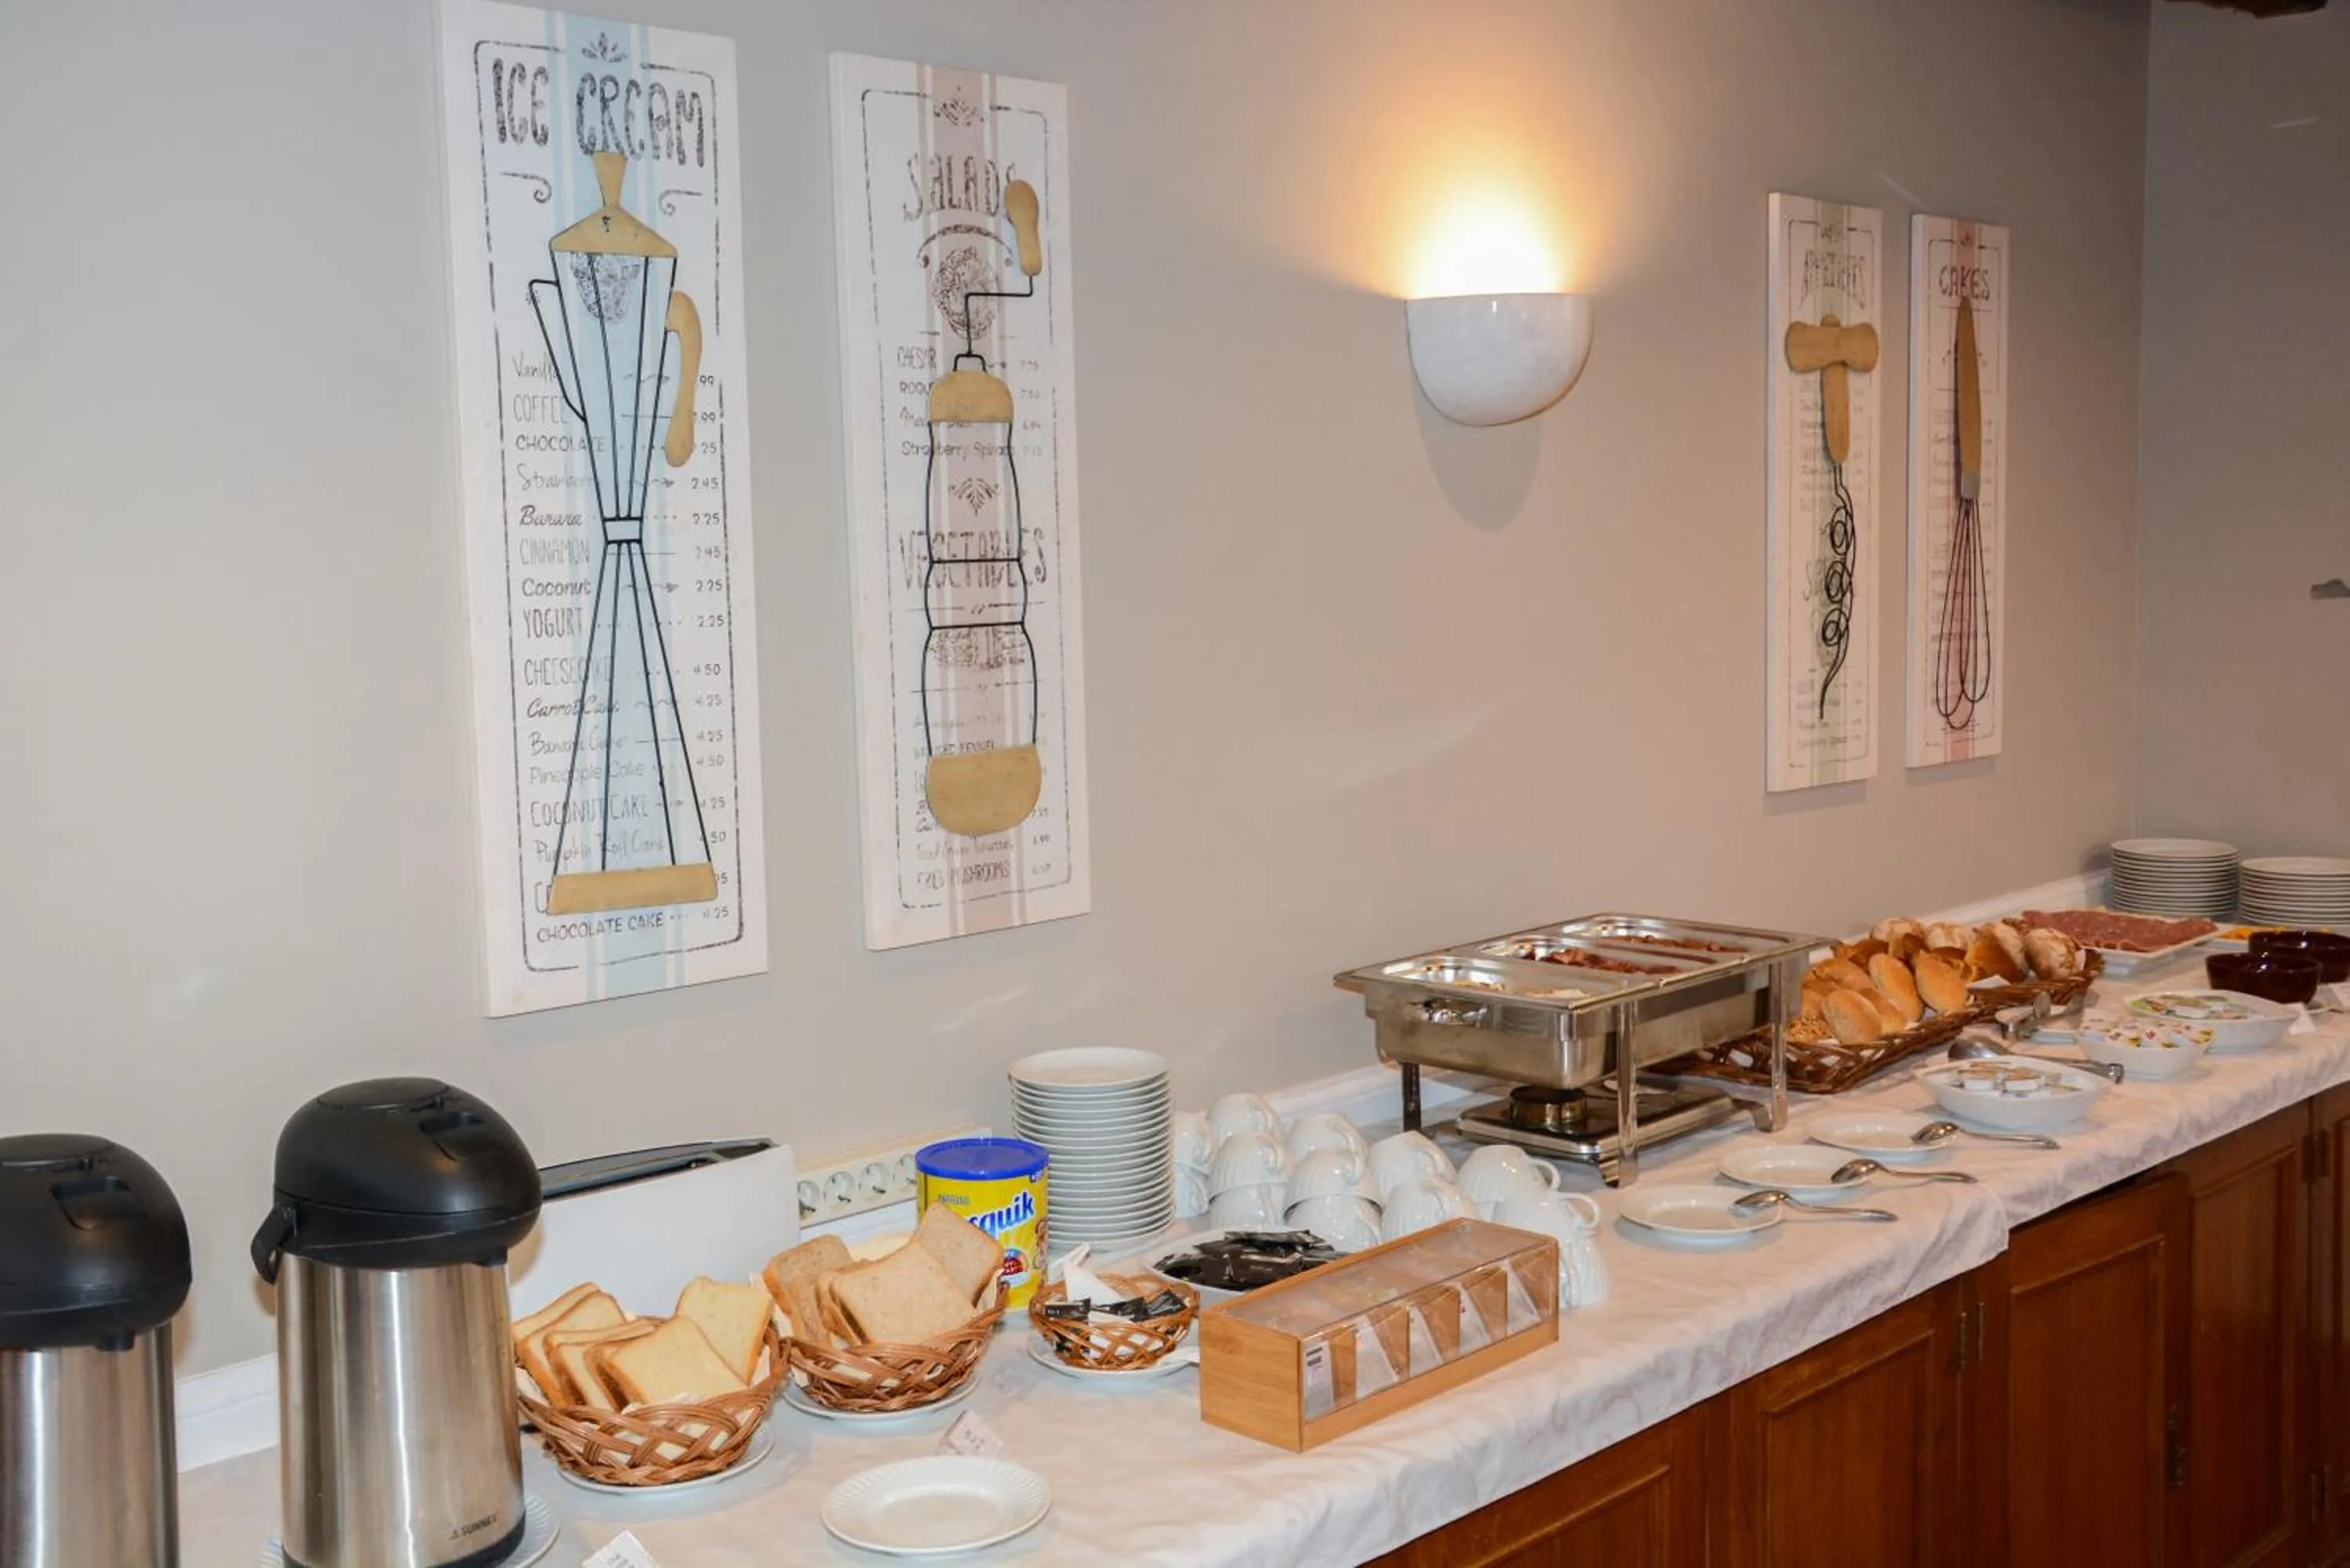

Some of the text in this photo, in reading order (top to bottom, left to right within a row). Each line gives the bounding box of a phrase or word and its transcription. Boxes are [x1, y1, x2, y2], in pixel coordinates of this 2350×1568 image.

[493, 59, 705, 168] ICE CREAM
[522, 578, 592, 597] Coconut
[523, 608, 584, 638] YOGURT
[537, 919, 623, 943] CHOCOLATE
[627, 911, 663, 928] CAKE
